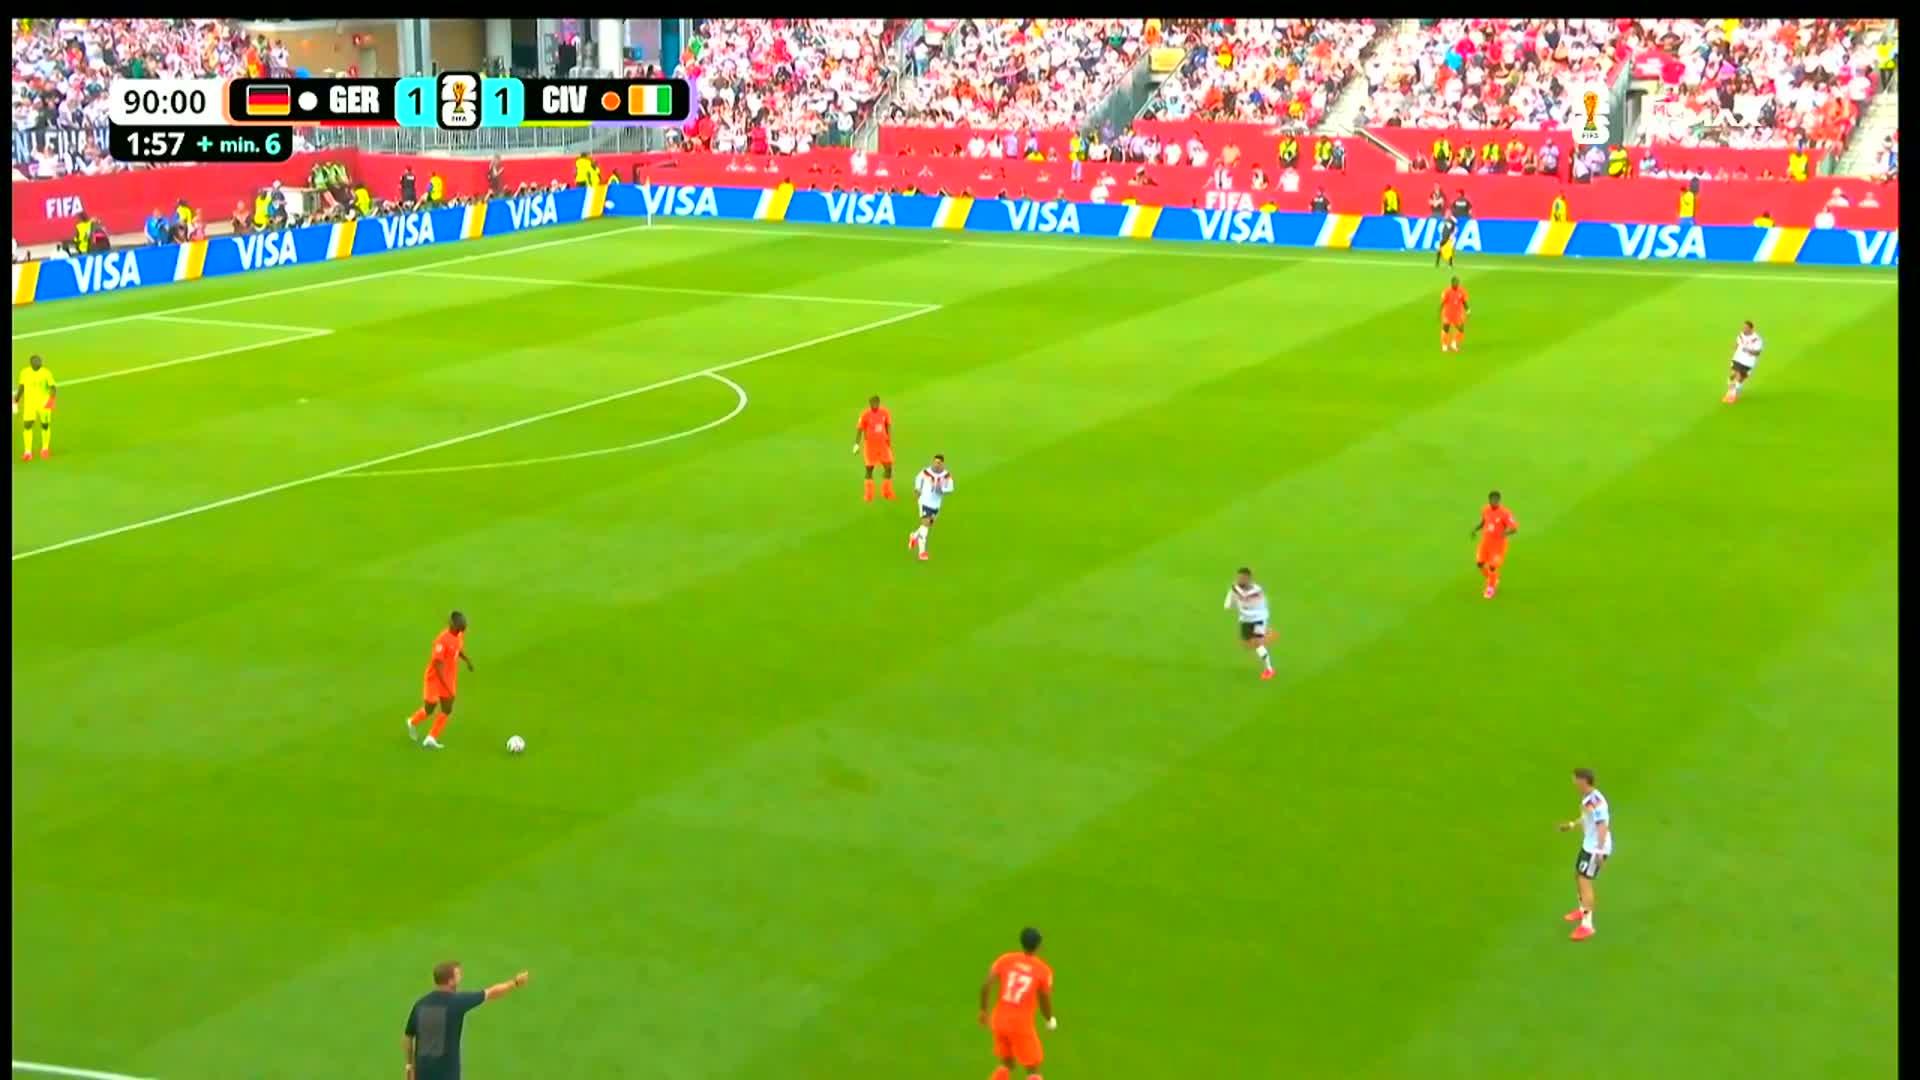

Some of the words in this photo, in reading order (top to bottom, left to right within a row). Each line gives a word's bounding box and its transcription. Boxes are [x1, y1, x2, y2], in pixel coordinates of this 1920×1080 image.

[45, 196, 83, 219] FIFA
[507, 194, 558, 230] VISA
[634, 183, 719, 217] VISA
[816, 192, 896, 225] VISA
[1001, 199, 1081, 234] VISA
[1205, 191, 1255, 210] FIFA
[378, 212, 435, 250] VISA
[1192, 208, 1276, 244] VISA
[1393, 216, 1483, 252] VIA
[1609, 223, 1707, 260] VISA
[232, 230, 297, 269] VISA
[1847, 229, 1899, 265] VI
[66, 250, 142, 294] VISA
[1002, 970, 1033, 1004] 17
